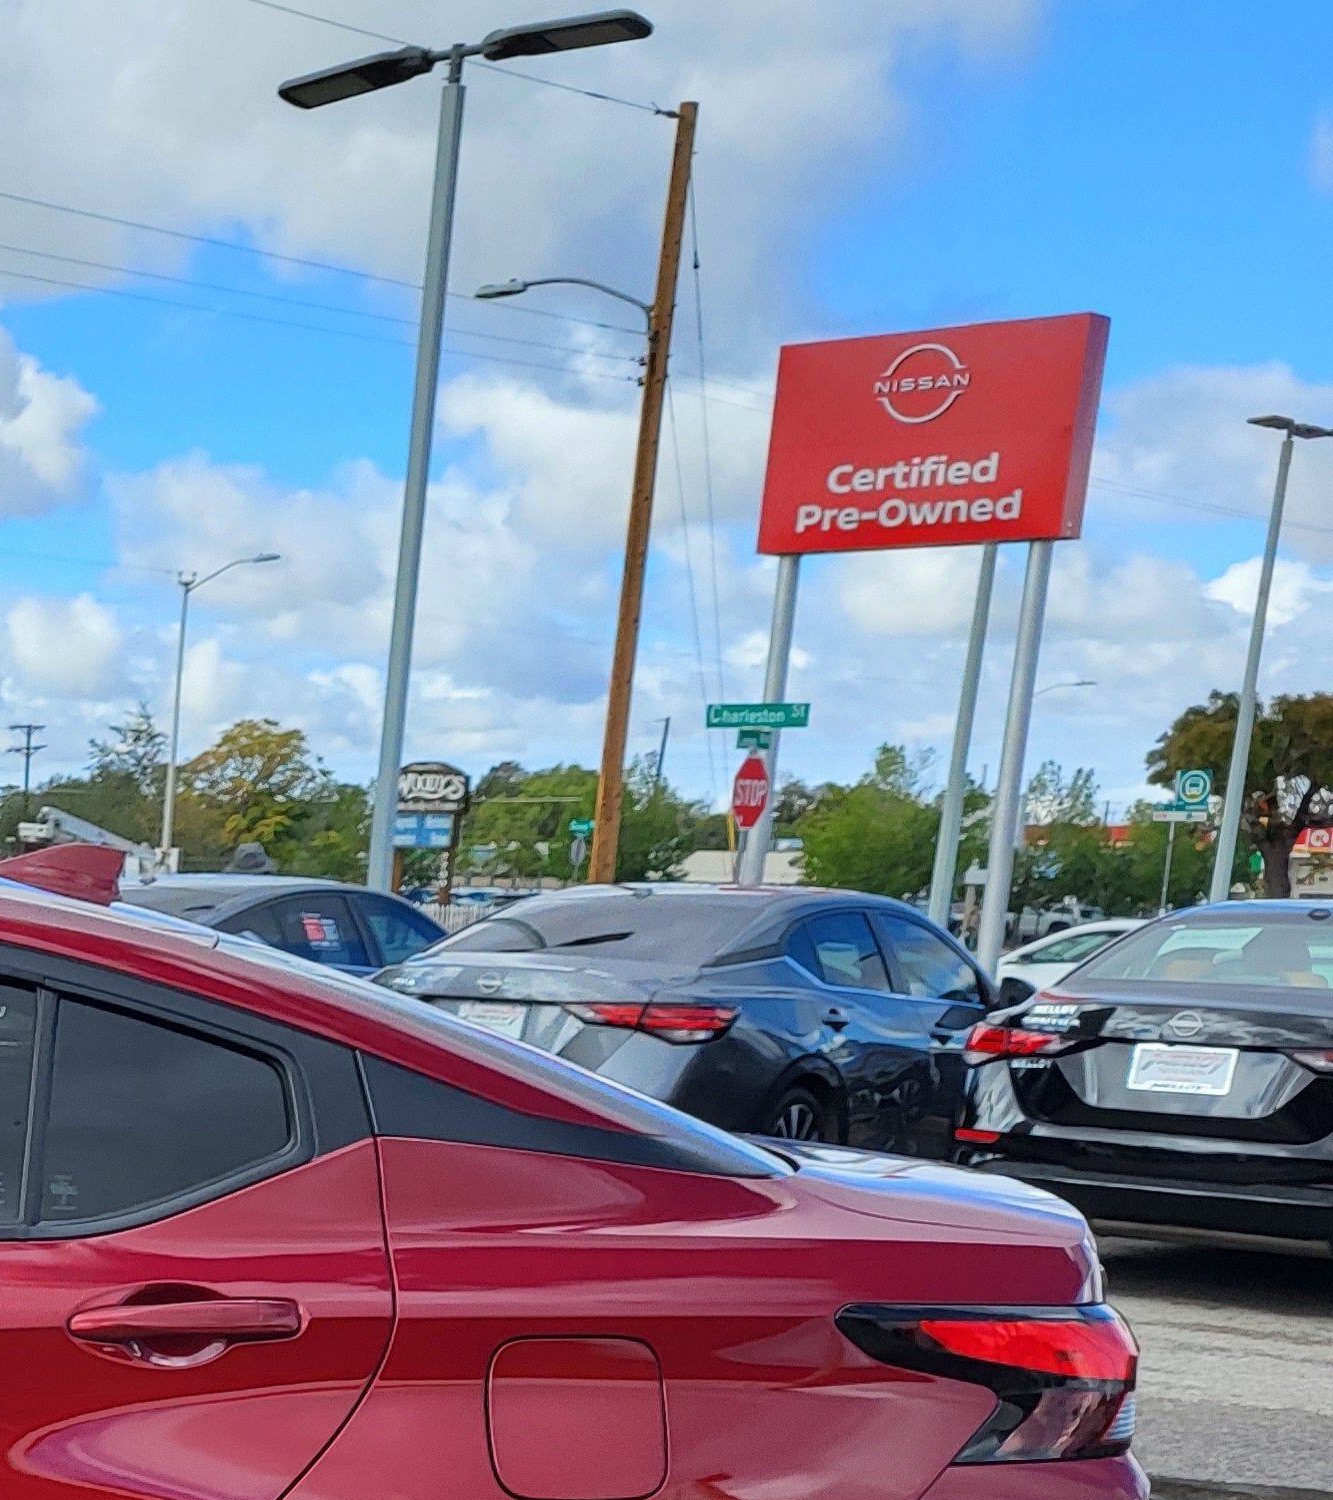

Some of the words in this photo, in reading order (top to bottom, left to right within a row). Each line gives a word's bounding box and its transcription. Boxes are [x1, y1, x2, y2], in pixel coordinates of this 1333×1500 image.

[874, 372, 971, 394] NISSAN
[827, 452, 1000, 494] Certified
[795, 488, 1023, 534] Pre-Owned
[735, 780, 767, 806] STOP
